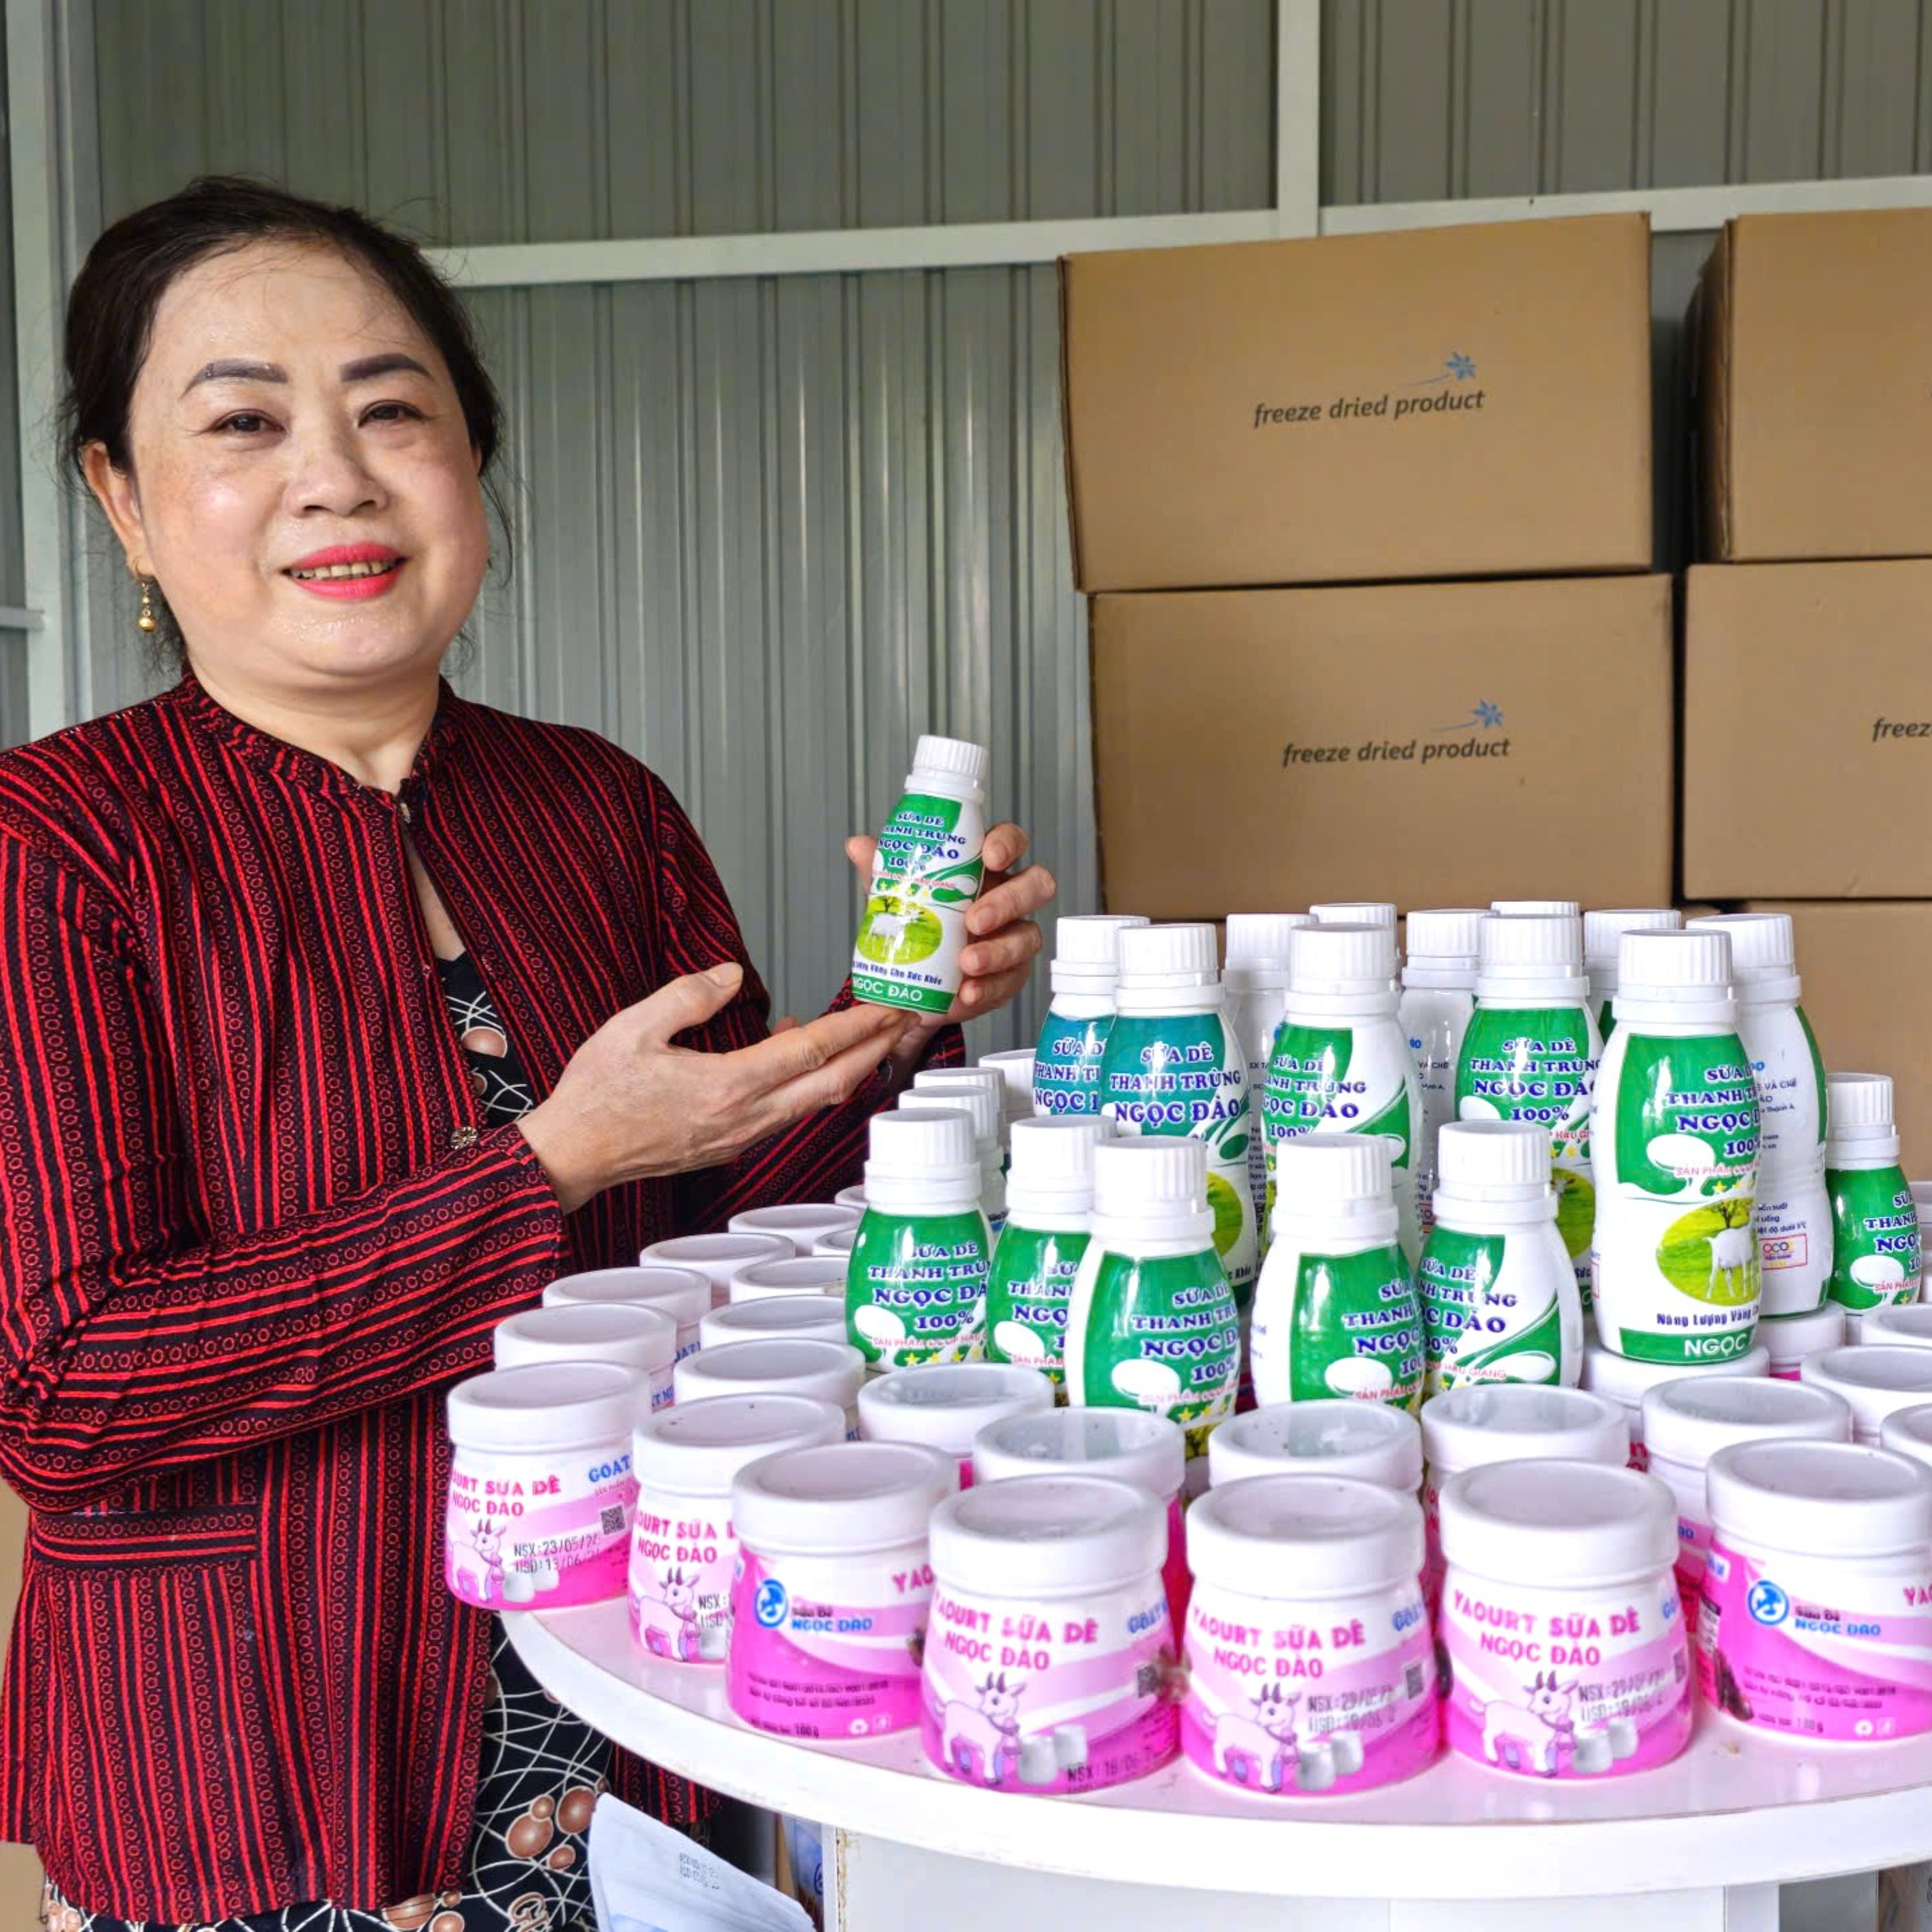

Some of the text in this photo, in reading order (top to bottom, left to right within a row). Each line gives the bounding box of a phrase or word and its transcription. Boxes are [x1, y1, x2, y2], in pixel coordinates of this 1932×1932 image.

[1254, 390, 1485, 429] freeze dried product
[1872, 717, 1932, 743] freez
[1282, 738, 1511, 768] freeze dried product
[1188, 1041, 1213, 1062] DÊ
[1549, 1037, 1576, 1052] DÊ
[1180, 1067, 1241, 1090] TRÙNG
[1473, 1079, 1546, 1097] NGỌC
[1034, 1090, 1084, 1113] NGỌC
[1264, 1096, 1359, 1119] GỌC ĐÀO
[1666, 1088, 1743, 1104] THANH
[1115, 1095, 1240, 1127] NGỌC ĐÀO
[1511, 1106, 1569, 1121] 100%
[1677, 1112, 1750, 1133] NGỌC
[954, 1240, 978, 1256] DÊ
[869, 1266, 942, 1279] THANH
[874, 1279, 987, 1307] NGỌC ĐÀ
[916, 1310, 974, 1329] 100%
[1014, 1305, 1067, 1326] NGỌ
[1132, 1314, 1212, 1331] THANH
[1345, 1307, 1414, 1327] THANH
[1143, 1333, 1222, 1357] NGỌC
[1684, 1333, 1747, 1356] NGỌC
[588, 1454, 631, 1482] GOAT
[533, 1474, 561, 1495] DÊ
[452, 1491, 480, 1513] NGỌC
[638, 1537, 717, 1564] NGỌC ĐÀO
[1454, 1589, 1537, 1633] YAOURT
[1609, 1607, 1640, 1636] DÊ
[1064, 1618, 1099, 1643] DÊ
[1332, 1619, 1366, 1648] DÊ
[945, 1631, 1050, 1670] NGỌC ĐÀO
[1481, 1631, 1600, 1666] NGỌC ĐÀO
[1214, 1647, 1323, 1678] NGỌC ĐÀO
